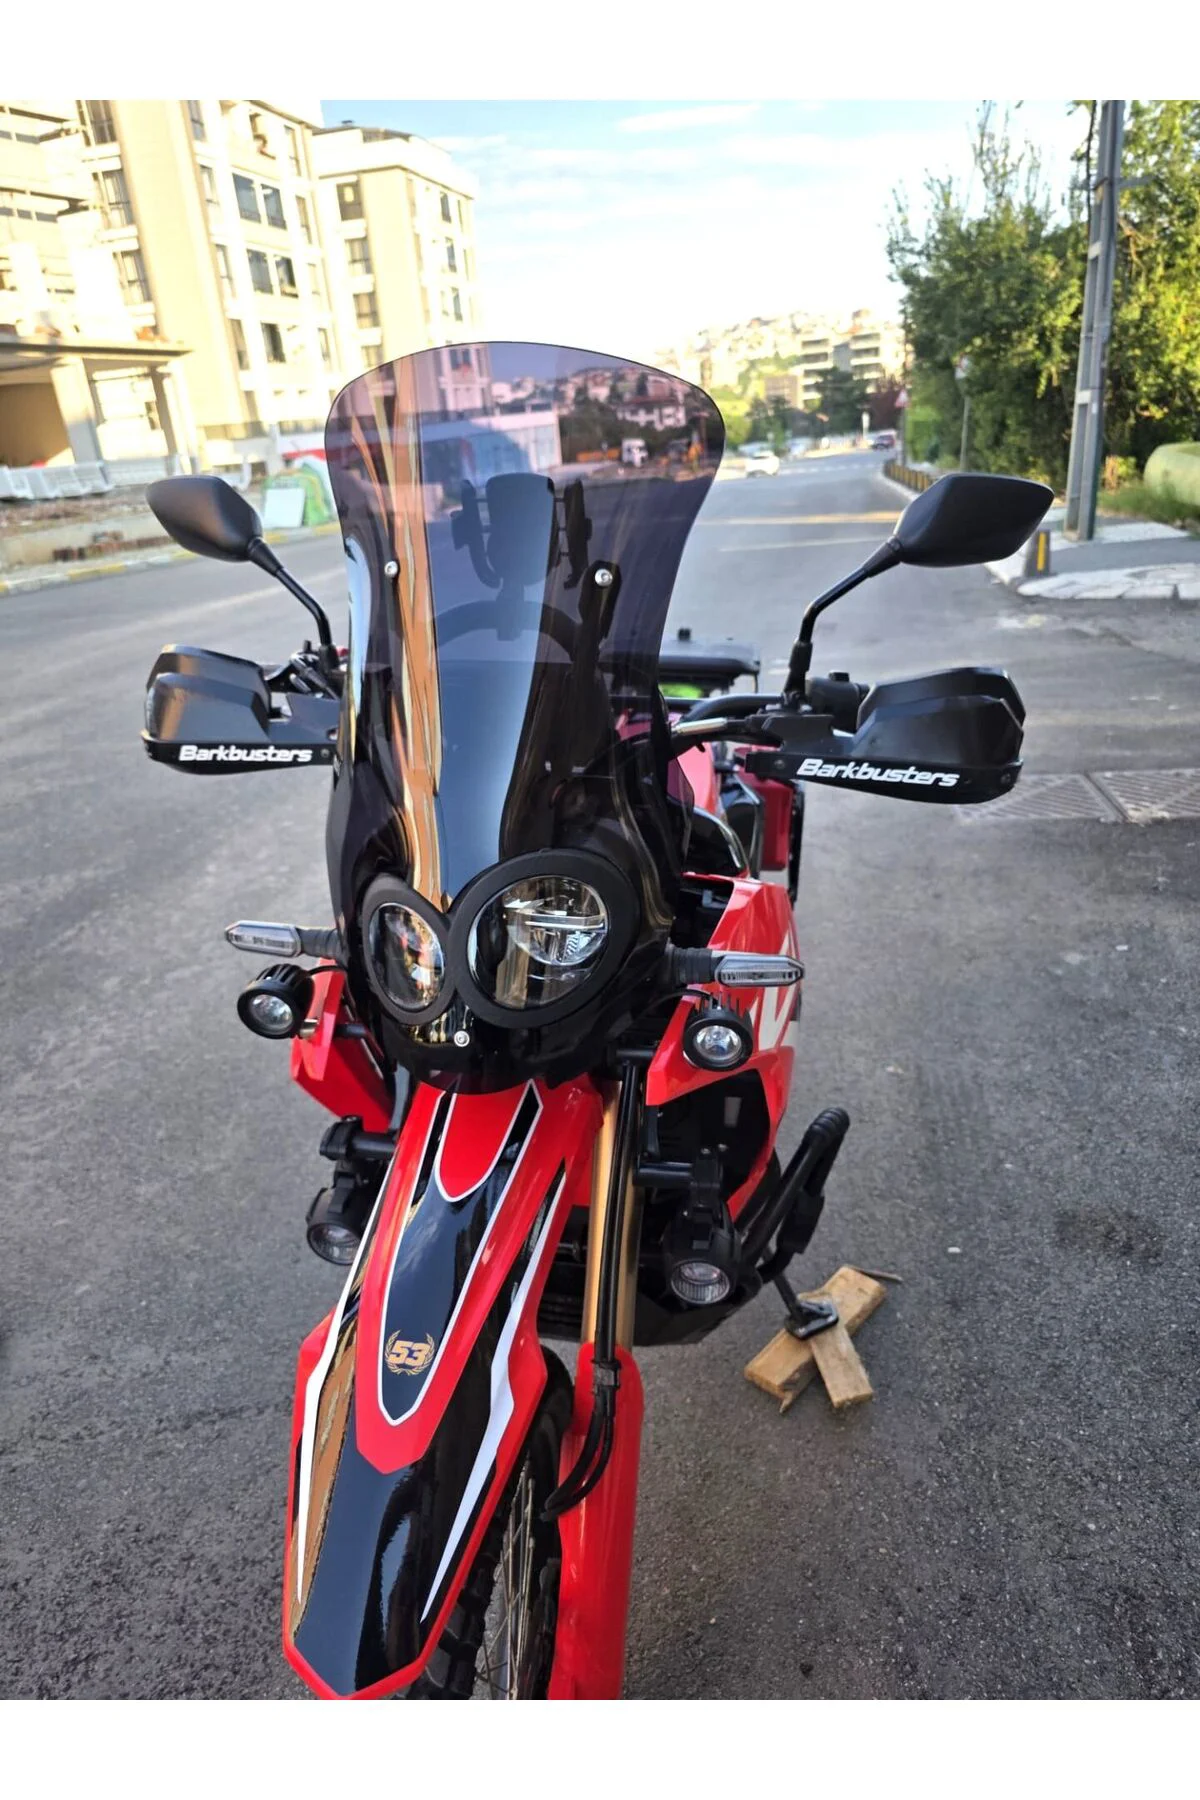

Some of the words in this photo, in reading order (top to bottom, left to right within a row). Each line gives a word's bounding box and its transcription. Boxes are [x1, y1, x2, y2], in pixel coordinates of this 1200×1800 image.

[178, 745, 312, 762] Barkbusters
[796, 758, 960, 787] Barkbusters
[388, 1340, 431, 1366] 53
